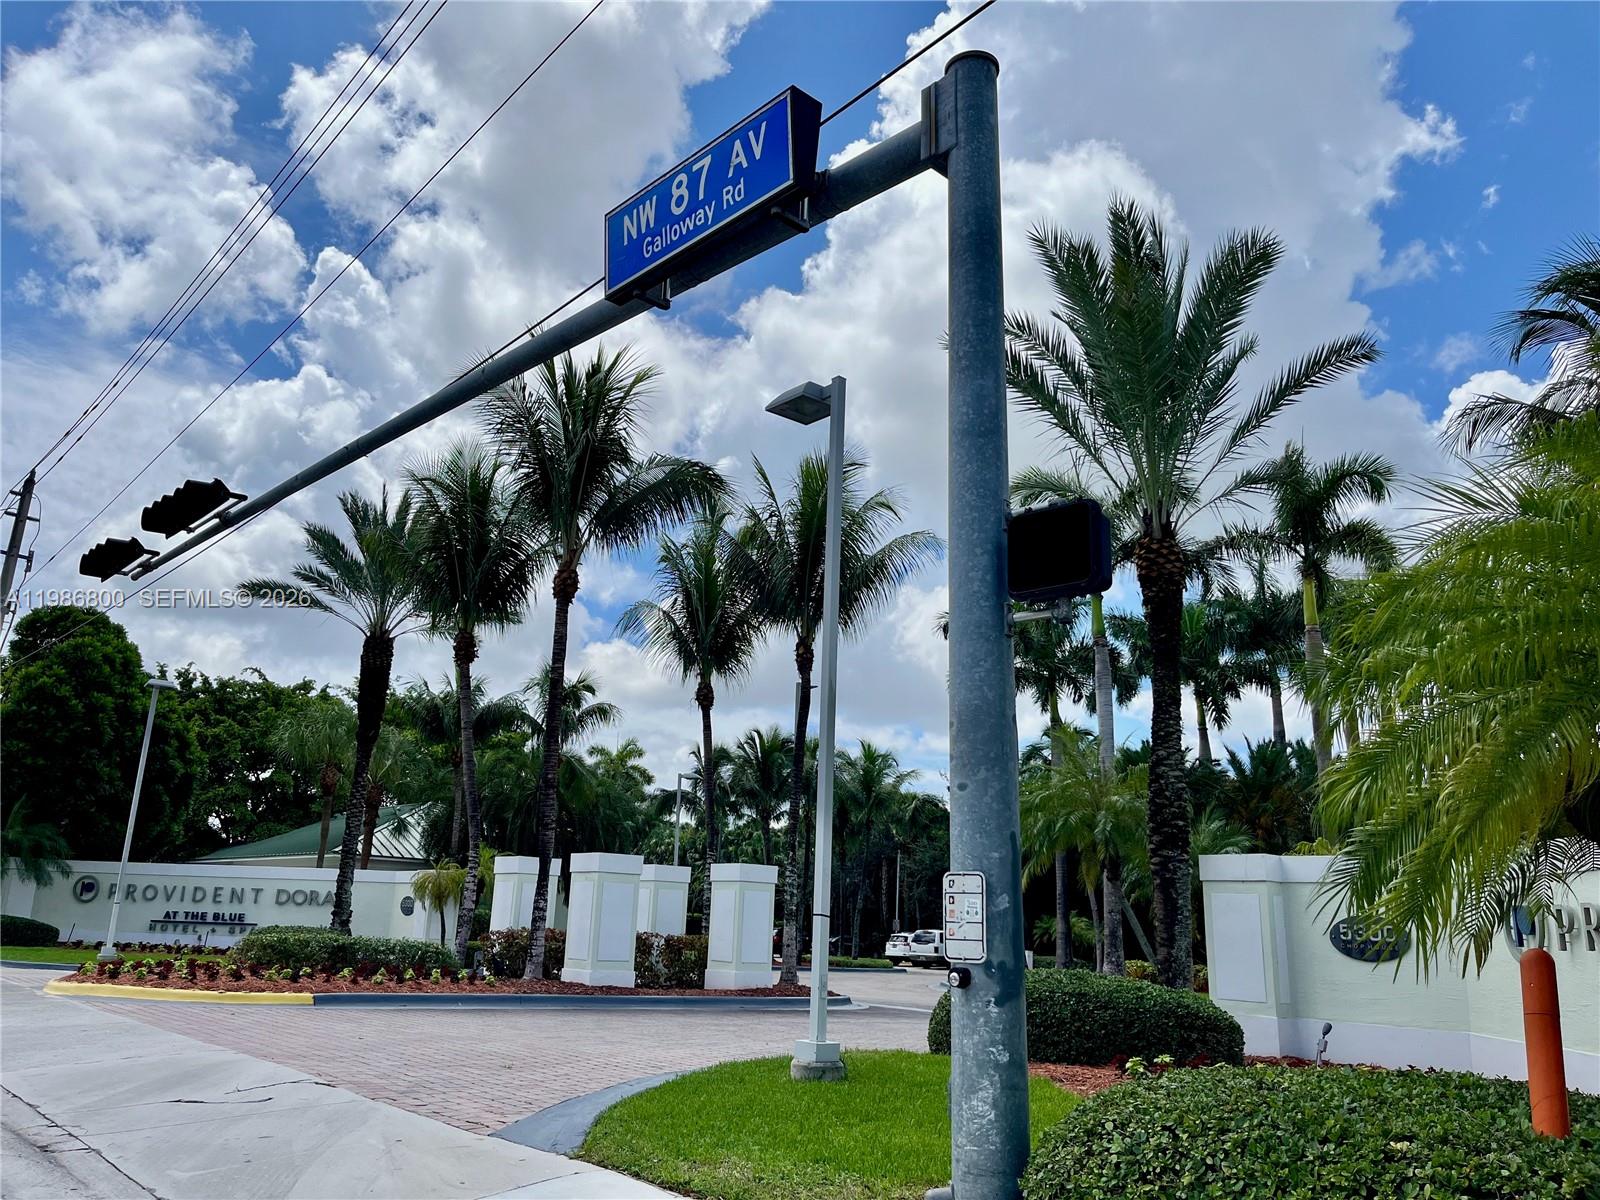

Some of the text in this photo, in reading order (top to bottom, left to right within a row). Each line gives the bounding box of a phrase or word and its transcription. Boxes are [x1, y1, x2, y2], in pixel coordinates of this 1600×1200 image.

[623, 120, 767, 246] NW 87 AV
[643, 177, 745, 258] Galloway Rd
[107, 882, 336, 906] PROVIDENT DORA
[163, 910, 246, 922] AT THE BLUE
[148, 923, 199, 934] HOTEL
